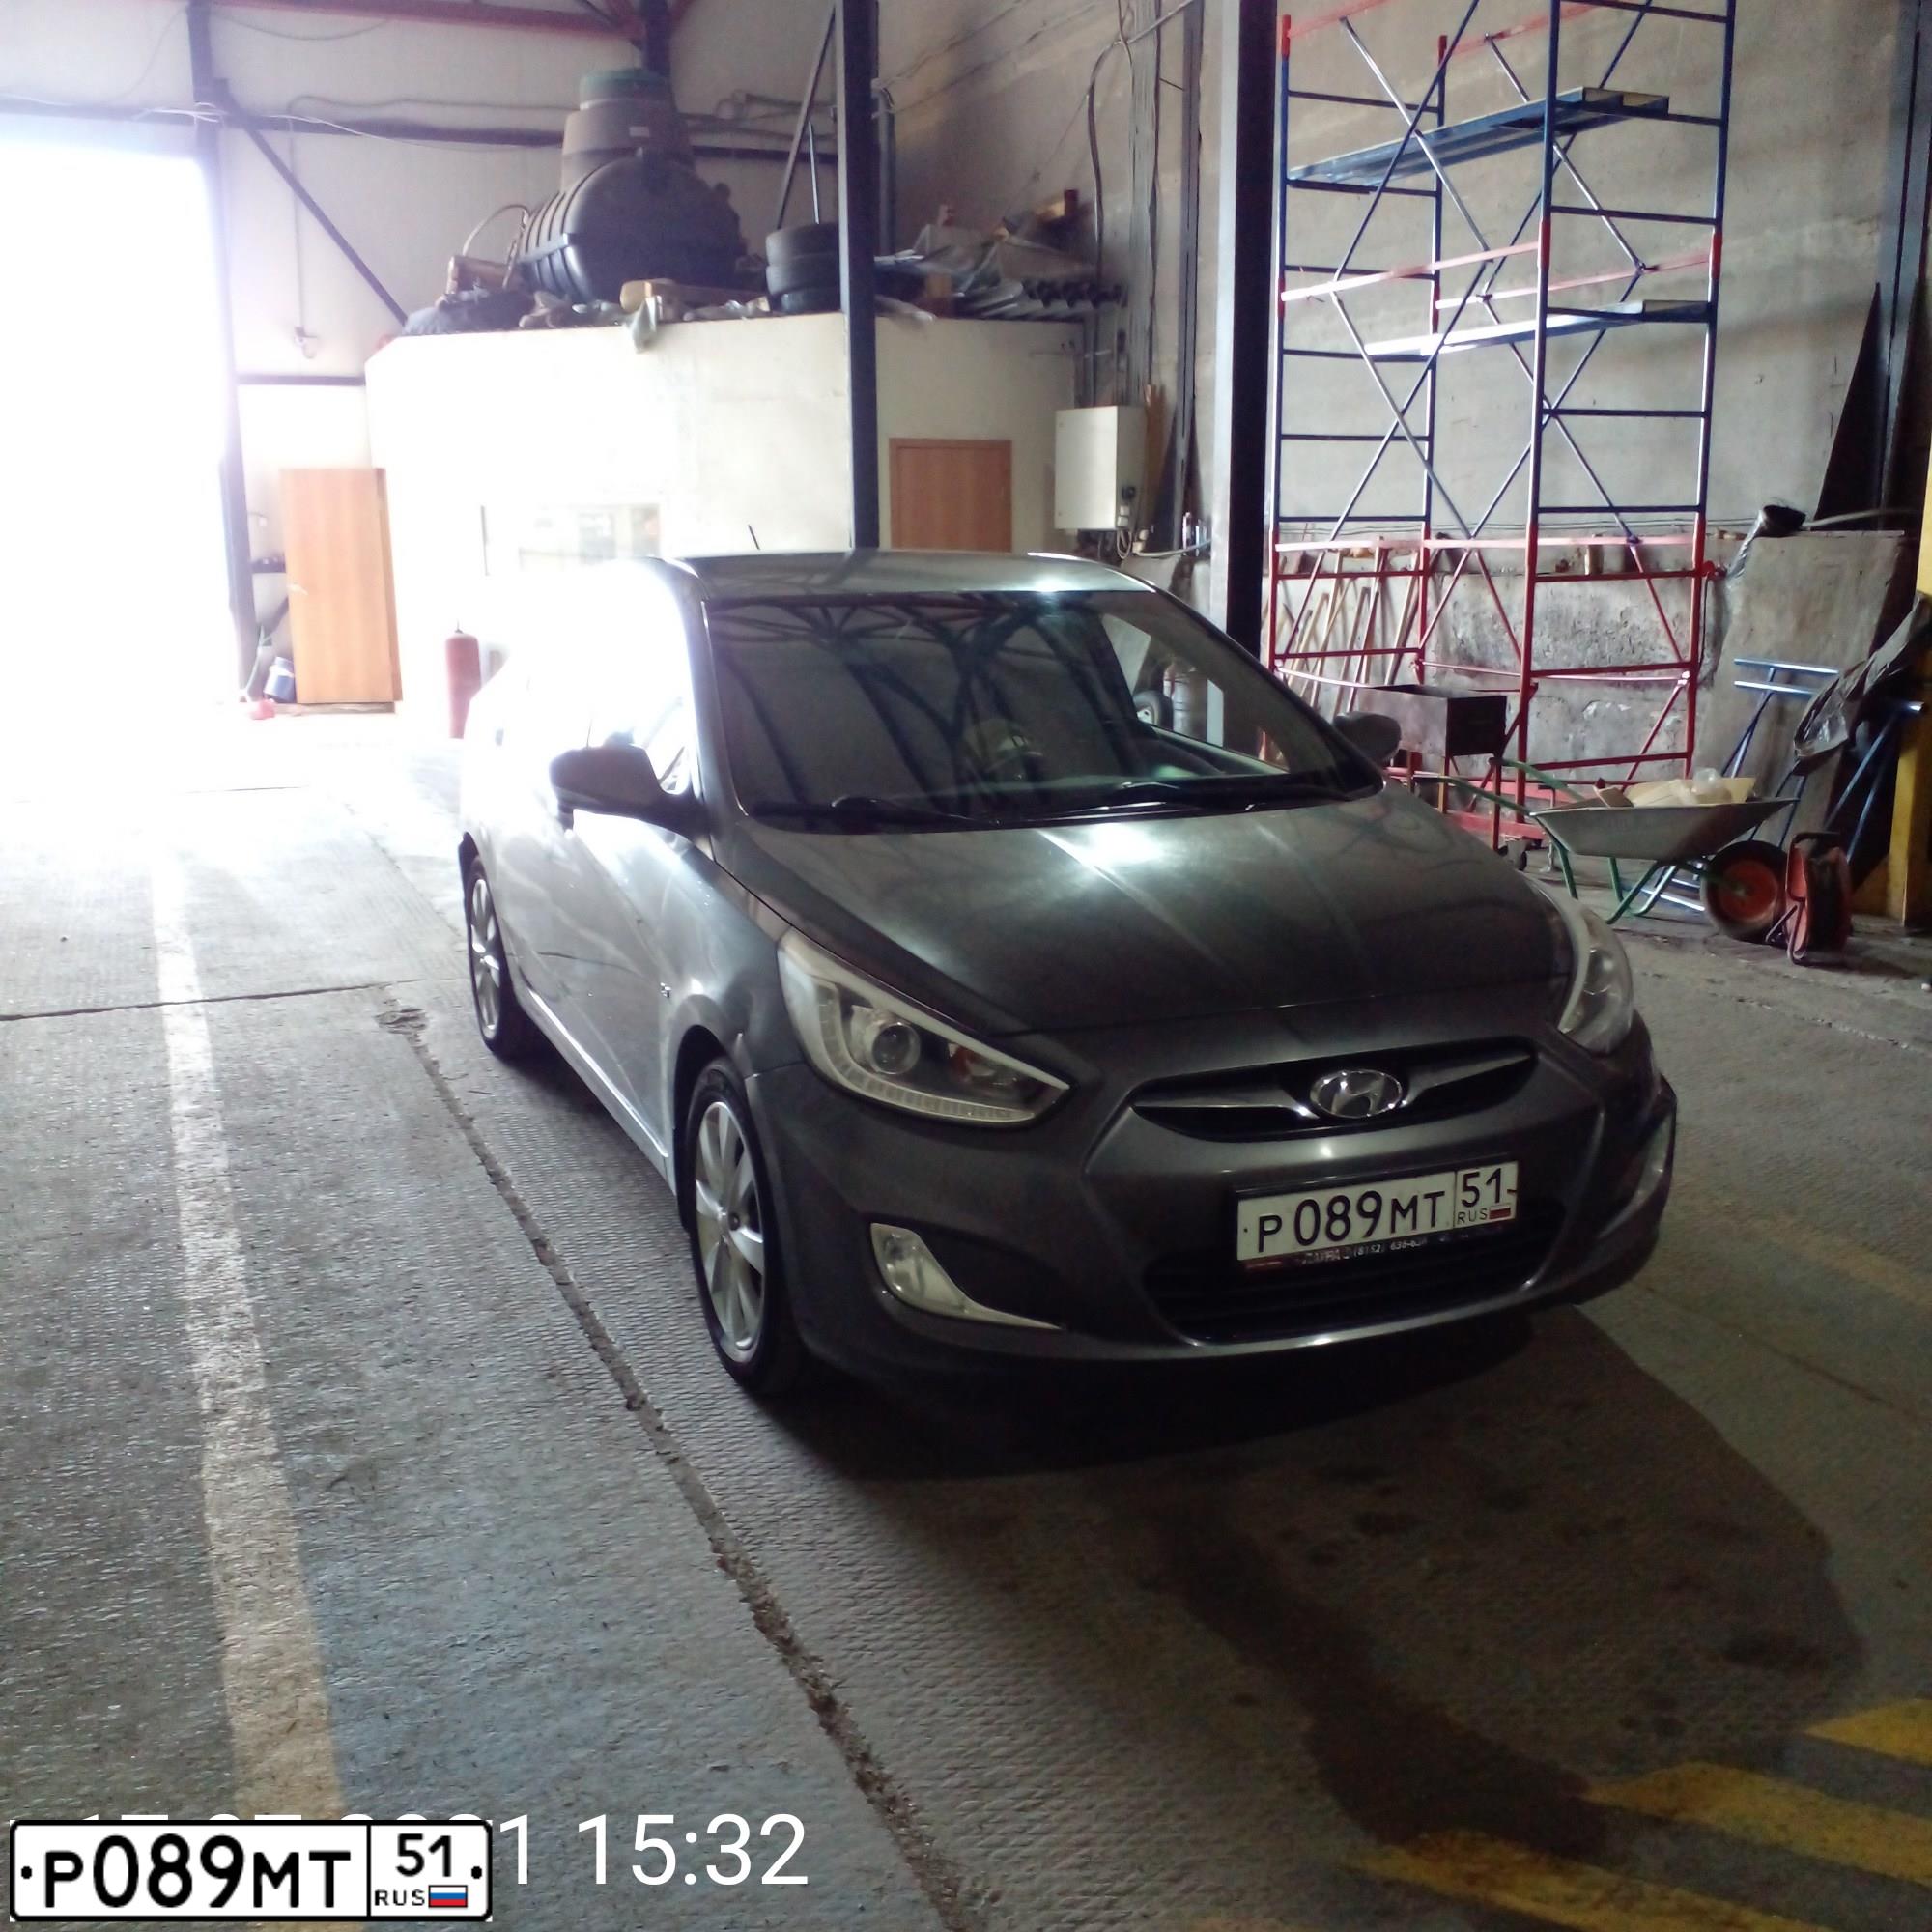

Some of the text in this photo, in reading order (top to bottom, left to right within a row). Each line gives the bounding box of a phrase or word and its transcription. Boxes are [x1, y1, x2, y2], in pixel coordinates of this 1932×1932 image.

[1461, 1167, 1503, 1208] 51
[1258, 1190, 1446, 1253] Р089МТ
[1457, 1208, 1488, 1225] RUS
